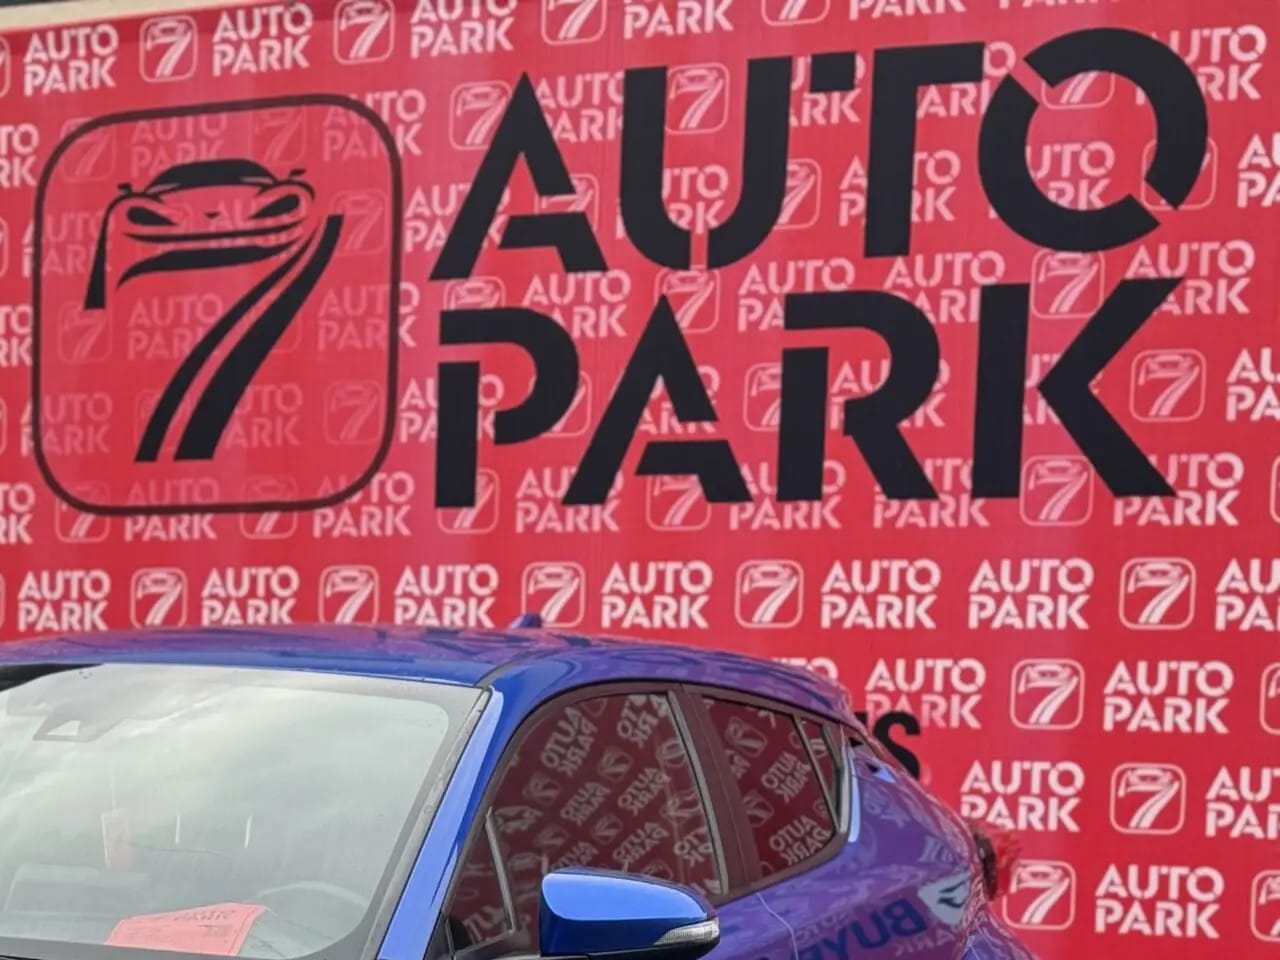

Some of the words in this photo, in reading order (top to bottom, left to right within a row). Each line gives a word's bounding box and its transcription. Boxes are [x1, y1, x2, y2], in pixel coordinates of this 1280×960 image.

[212, 3, 313, 44] AUTO
[411, 17, 514, 59] PARK
[624, 0, 734, 40] PARK
[24, 24, 118, 64] AUTO
[213, 35, 310, 76] PARK
[24, 55, 116, 96] PARK
[429, 26, 1208, 281] AUTO
[739, 258, 854, 296] AUTO
[884, 251, 1005, 289] AUTO
[1125, 240, 1255, 278] AUTO
[522, 269, 631, 307] AUTO
[434, 276, 1187, 509] PARK
[314, 505, 410, 537] PARK
[516, 499, 619, 532] PARK
[730, 496, 840, 529] PARK
[874, 494, 989, 528] PARK
[1114, 490, 1239, 525] PARK
[124, 512, 218, 543] PARK
[18, 570, 110, 602] AUTO
[202, 566, 299, 598] AUTO
[394, 564, 498, 597] AUTO
[601, 561, 712, 594] AUTO
[821, 559, 941, 594] AUTO
[969, 558, 1094, 593] AUTO
[18, 600, 108, 632] PARK
[202, 598, 295, 627] PARK
[394, 596, 494, 629] PARK
[601, 594, 709, 628] PARK
[821, 592, 937, 629] PARK
[968, 593, 1089, 629] PARK
[865, 658, 986, 693] AUTO
[1104, 661, 1233, 697] AUTO
[866, 693, 981, 728] PARK
[1104, 696, 1229, 733] PARK
[961, 760, 1084, 796] AUTO
[960, 795, 1079, 833] PARK
[1096, 864, 1224, 902] AUTO
[1096, 898, 1219, 938] PARK
